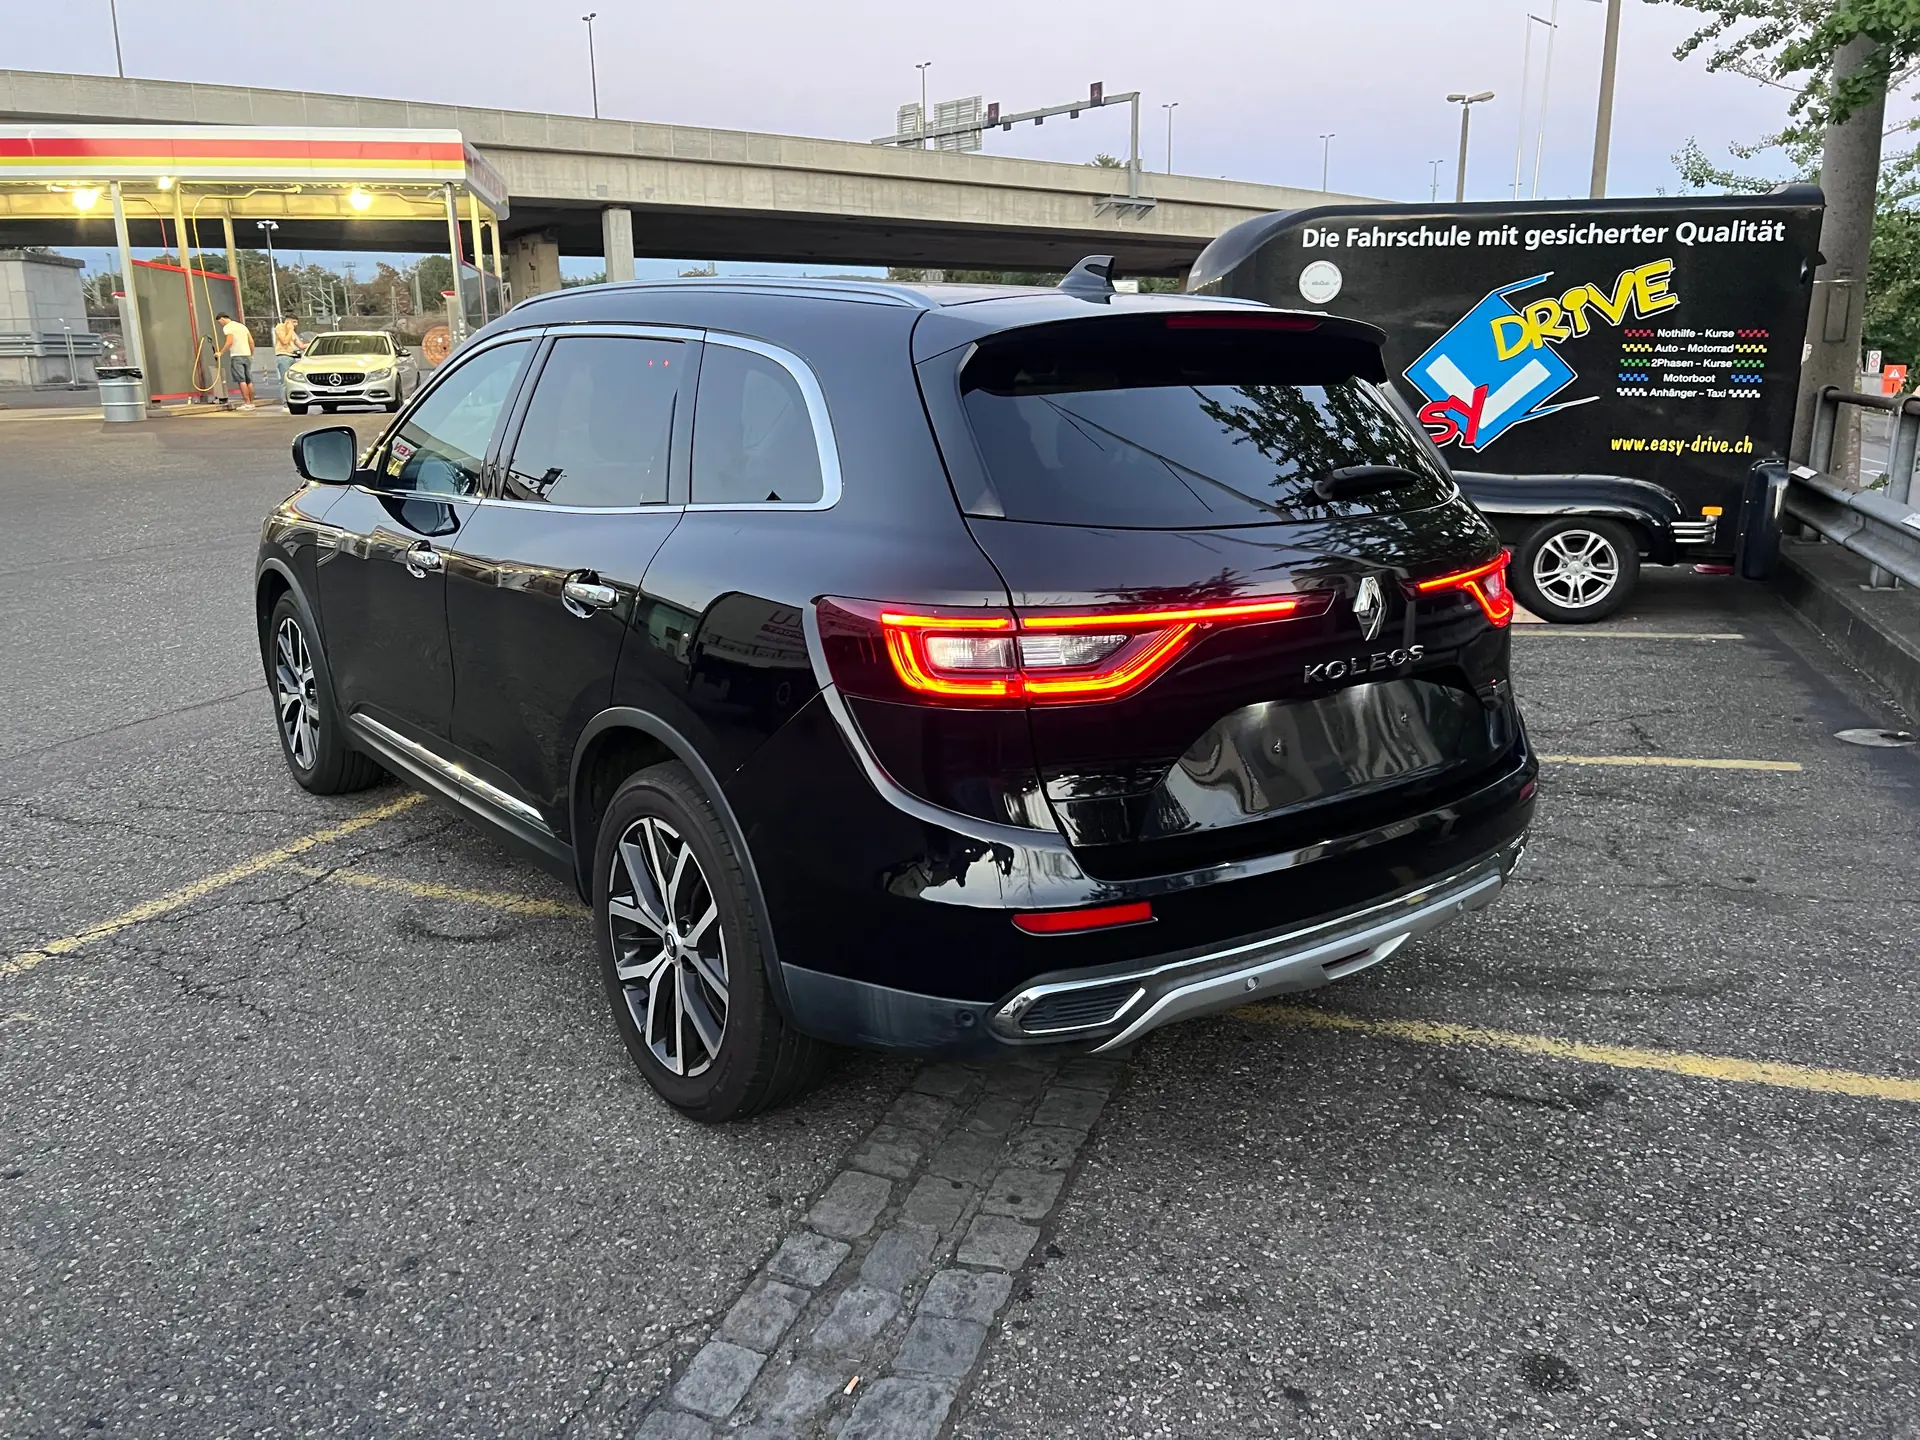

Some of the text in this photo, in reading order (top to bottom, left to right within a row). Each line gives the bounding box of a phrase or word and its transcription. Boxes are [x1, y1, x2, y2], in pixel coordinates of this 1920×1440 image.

[1302, 219, 1786, 251] Die Fahrschule mit gesicherter Qualität
[1490, 258, 1680, 361] DRIVE
[1656, 328, 1696, 338] Nothilfe
[1704, 328, 1735, 338] Kurse
[1654, 343, 1679, 353] Auto
[1687, 343, 1734, 353] Motorrad
[1651, 358, 1694, 368] 2Phasen
[1703, 358, 1733, 368] Kurse
[1662, 373, 1716, 383] Motorboot
[1649, 387, 1698, 399] Anhänger
[1706, 388, 1727, 398] Taxi
[1418, 384, 1489, 446] SY
[1611, 434, 1753, 456] www.easy-drive.ch
[1303, 645, 1425, 684] KOLEOS
